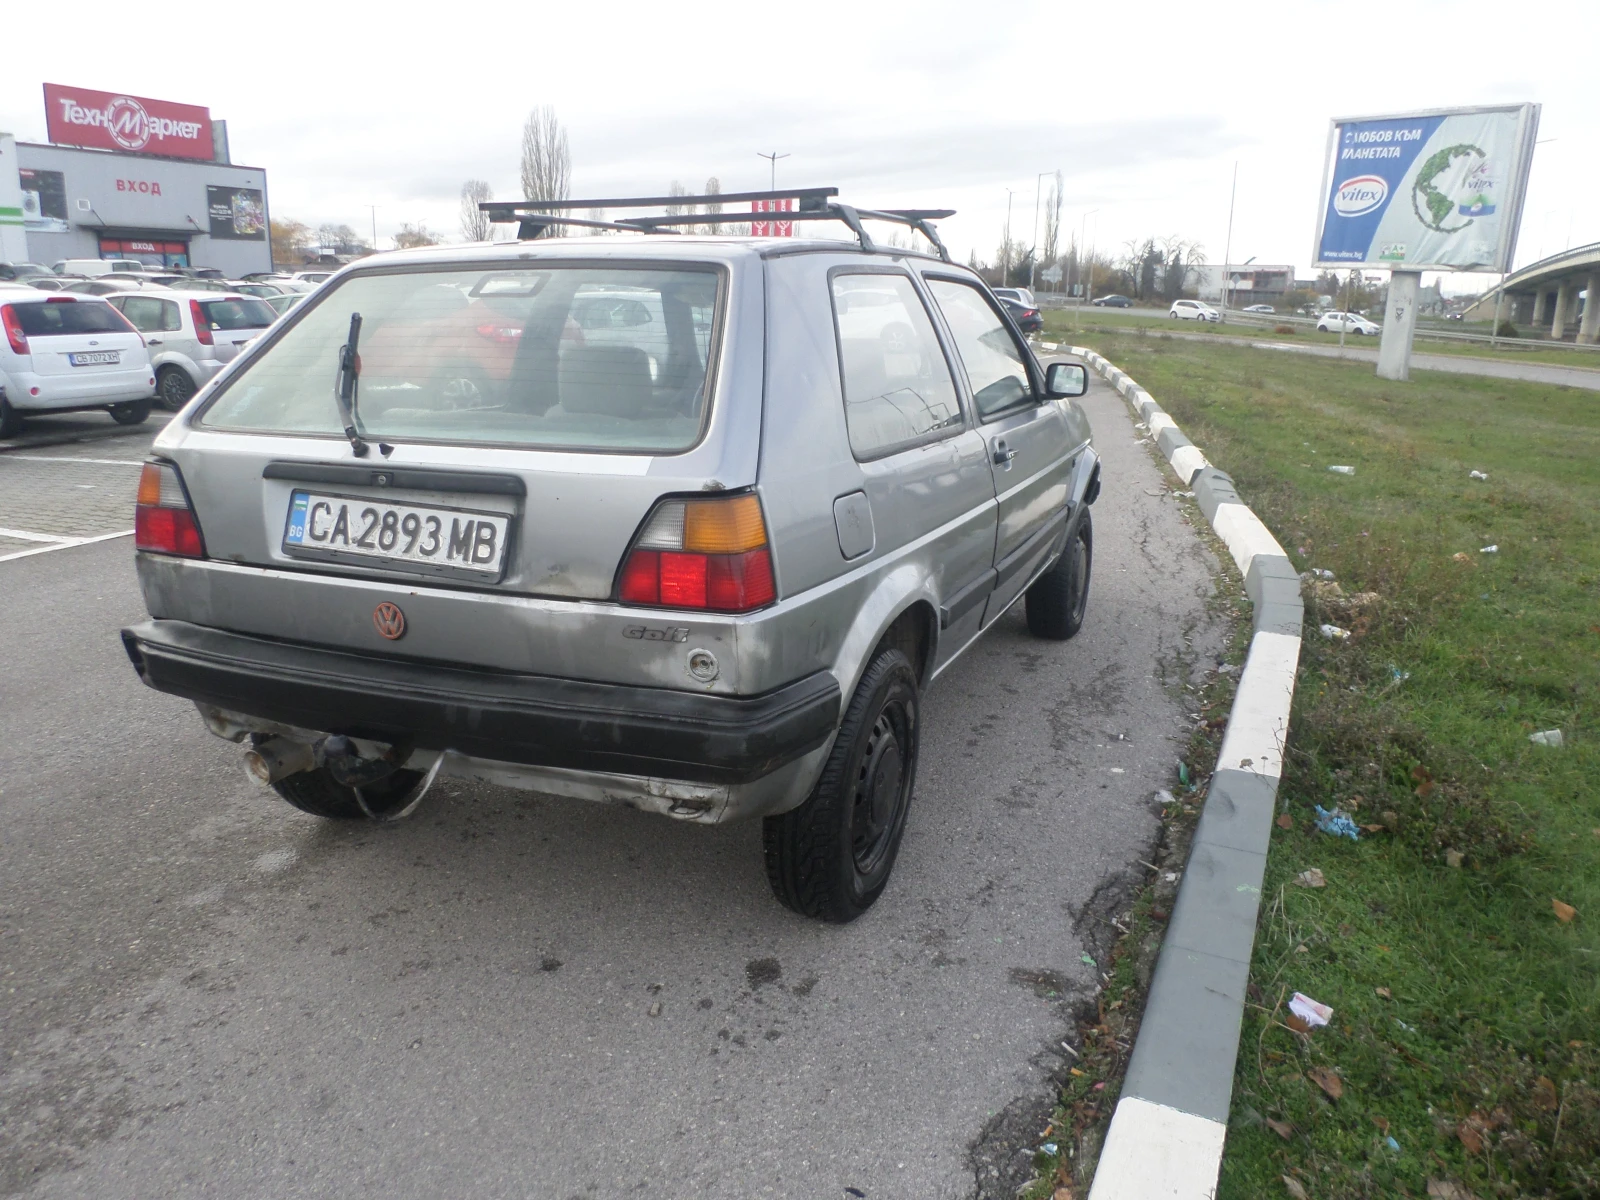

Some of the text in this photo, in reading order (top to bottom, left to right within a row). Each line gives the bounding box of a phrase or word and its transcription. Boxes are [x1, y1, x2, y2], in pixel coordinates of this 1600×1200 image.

[1394, 129, 1422, 141] КЪМ
[116, 179, 162, 197] ВХОД
[1341, 188, 1379, 202] vitex
[131, 242, 155, 252] ВХОД
[289, 524, 303, 538] BG
